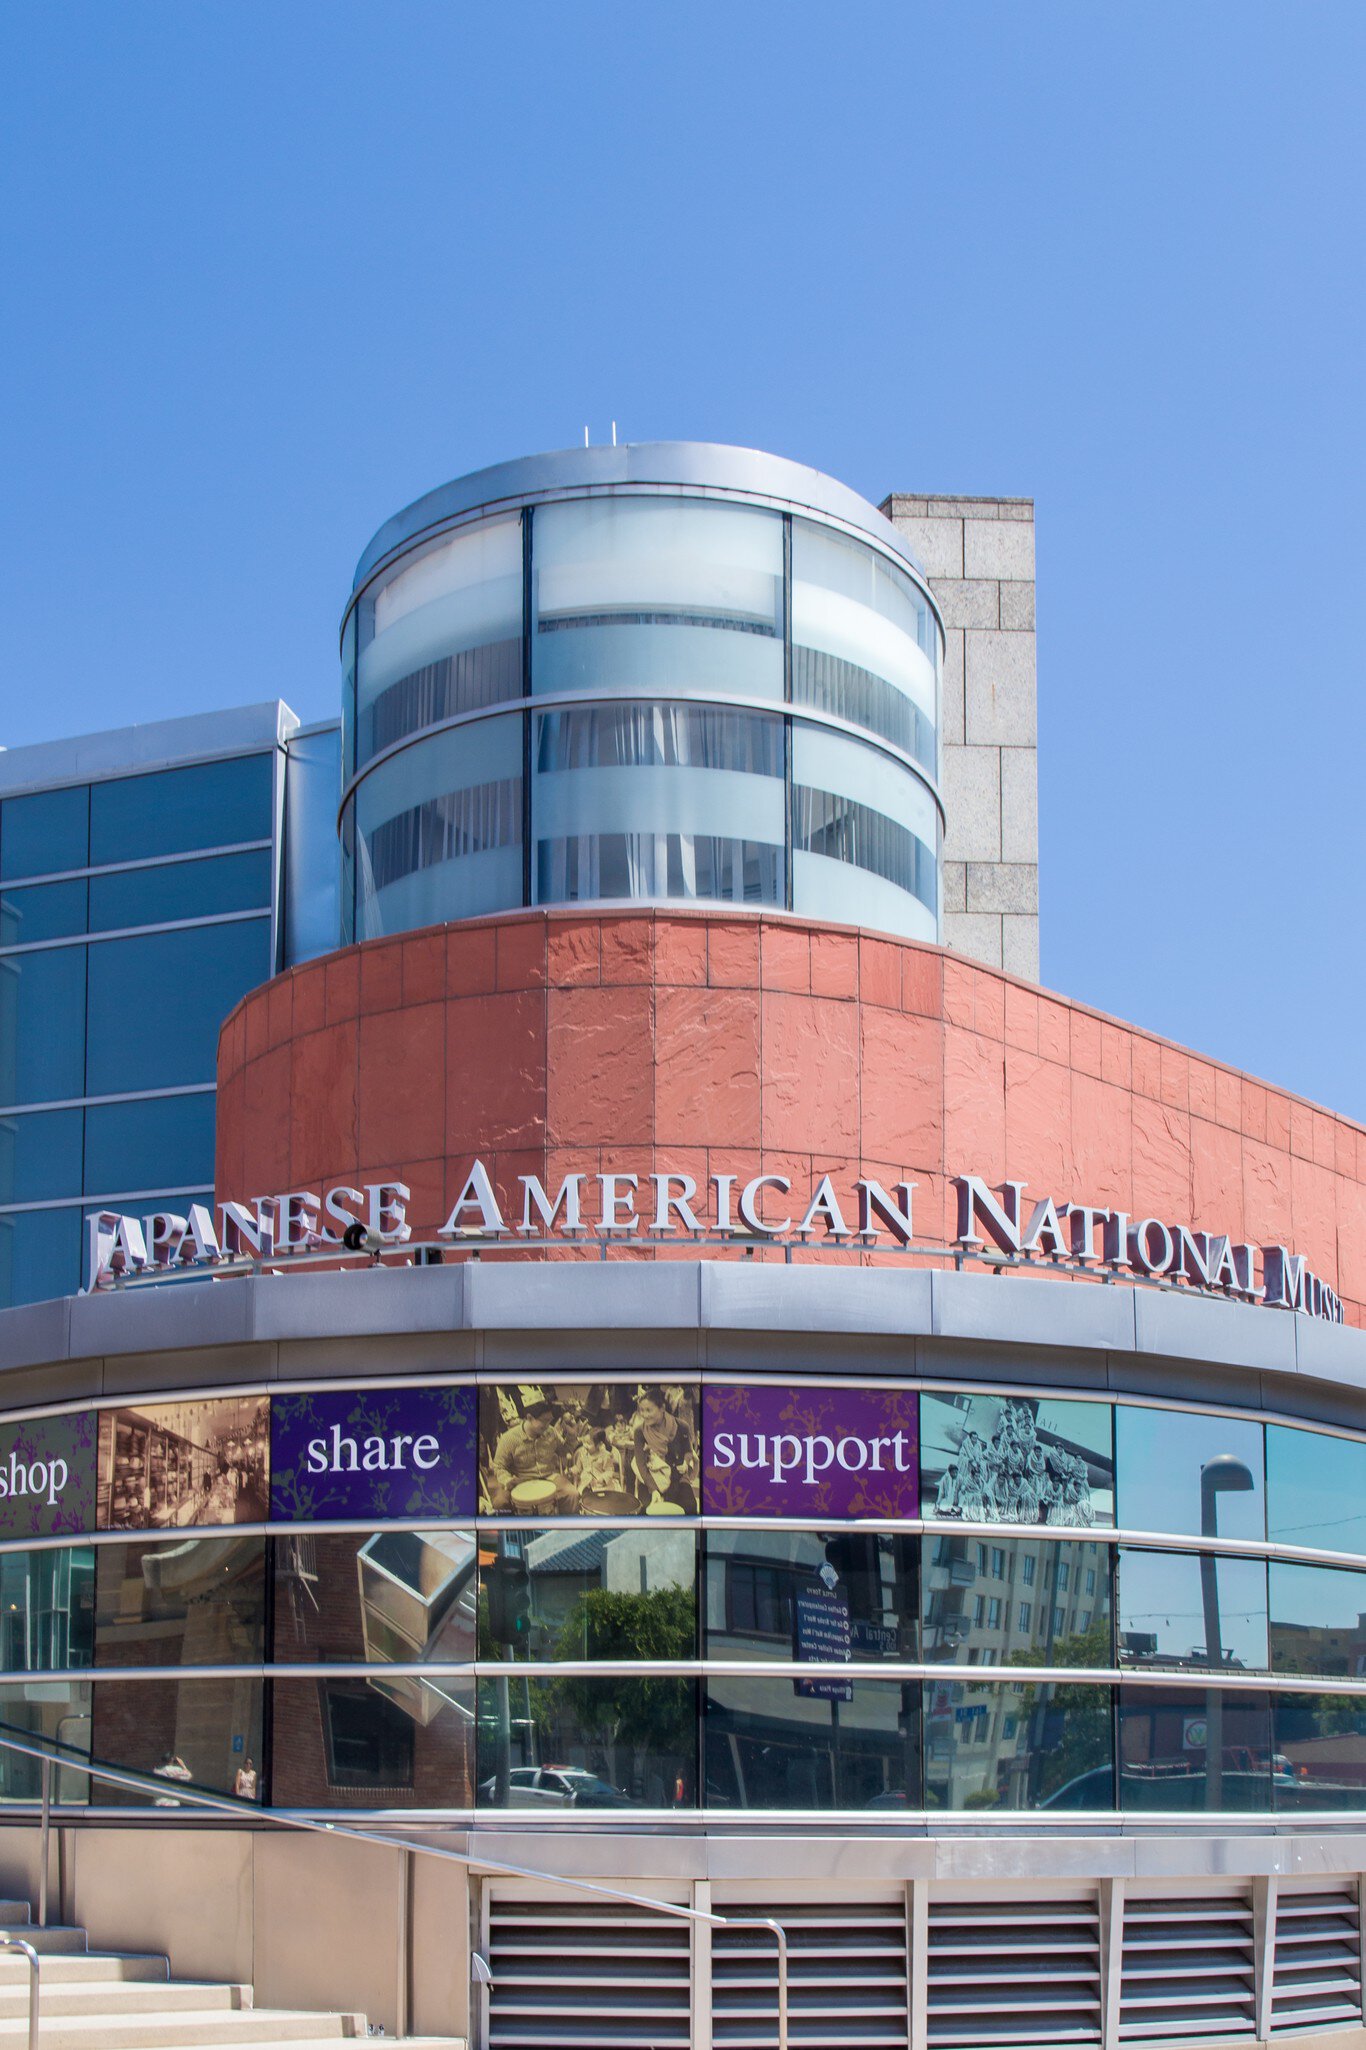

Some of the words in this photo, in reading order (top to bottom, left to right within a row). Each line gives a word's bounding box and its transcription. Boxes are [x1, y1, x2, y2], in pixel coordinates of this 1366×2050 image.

[78, 1182, 412, 1297] JAPANESE
[438, 1159, 918, 1244] AMERICAN
[951, 1174, 1267, 1298] NATIONAL
[306, 1424, 441, 1474] share
[712, 1430, 911, 1485] support
[0, 1451, 68, 1506] shop
